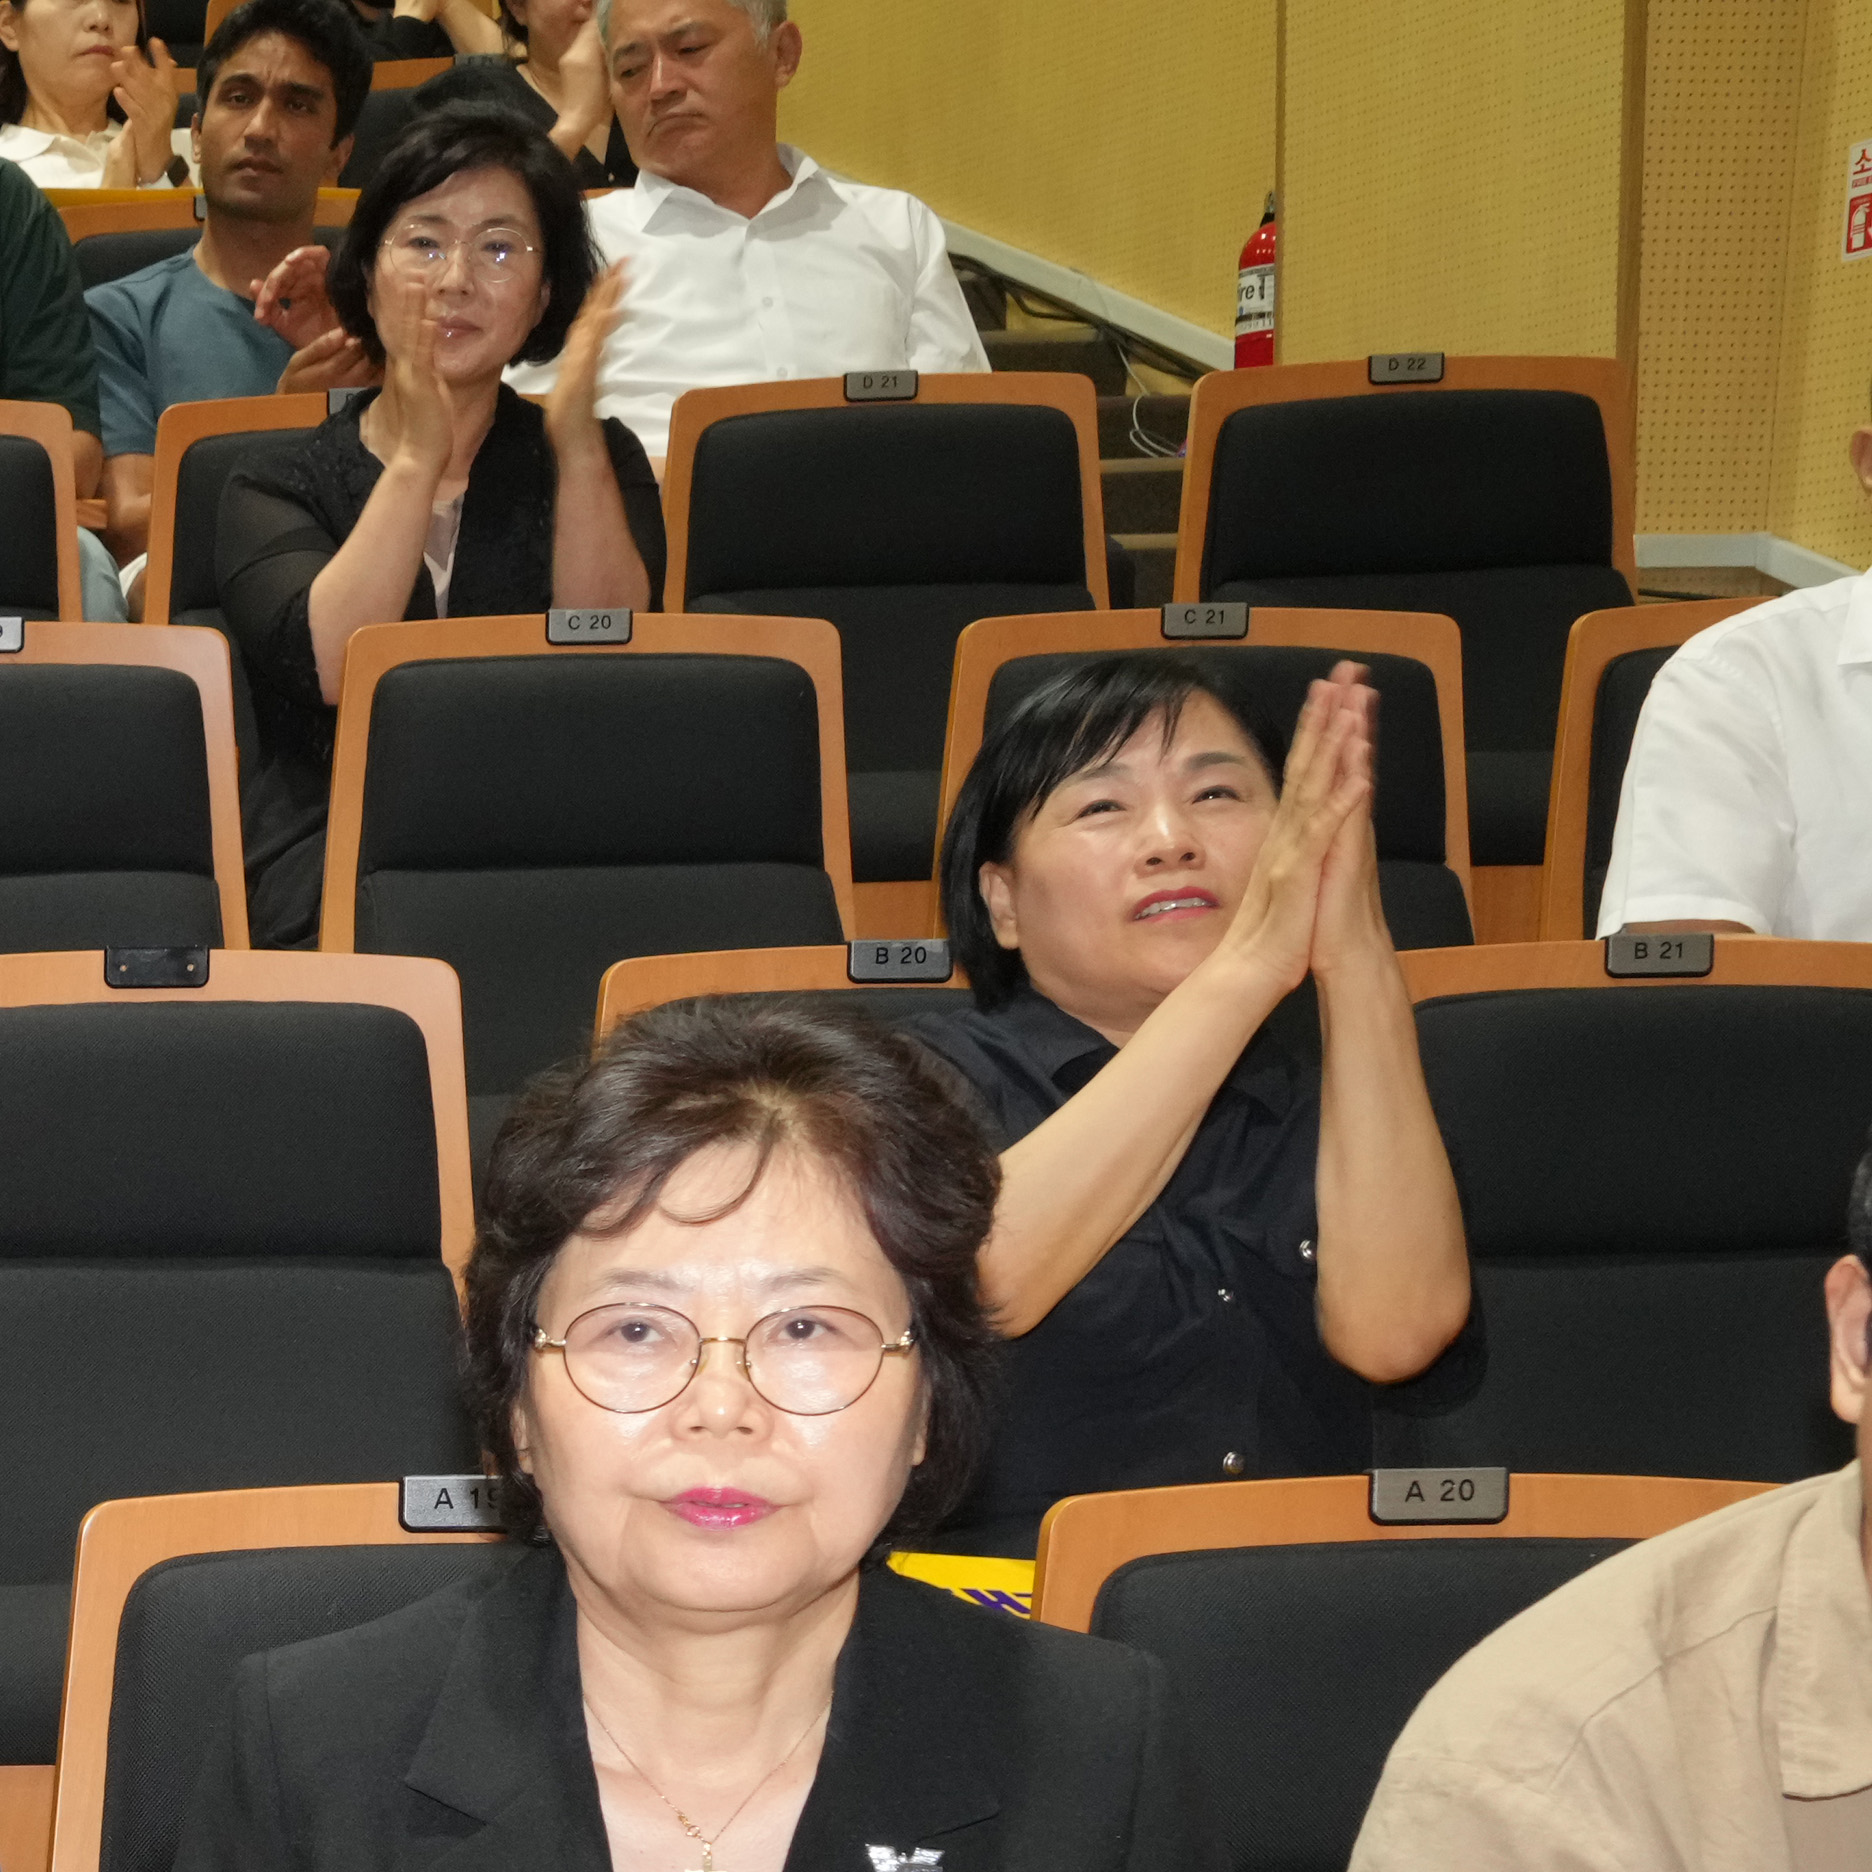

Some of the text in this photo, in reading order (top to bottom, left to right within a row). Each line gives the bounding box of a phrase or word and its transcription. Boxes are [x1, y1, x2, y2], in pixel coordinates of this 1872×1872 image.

[1388, 357, 1426, 371] D 22
[863, 375, 898, 389] D 21
[568, 614, 612, 630] C 20
[1184, 609, 1225, 624] C 21
[875, 946, 928, 964] B 20
[1635, 941, 1683, 959] B 21
[434, 1487, 454, 1509] A
[1404, 1479, 1475, 1502] A 20
